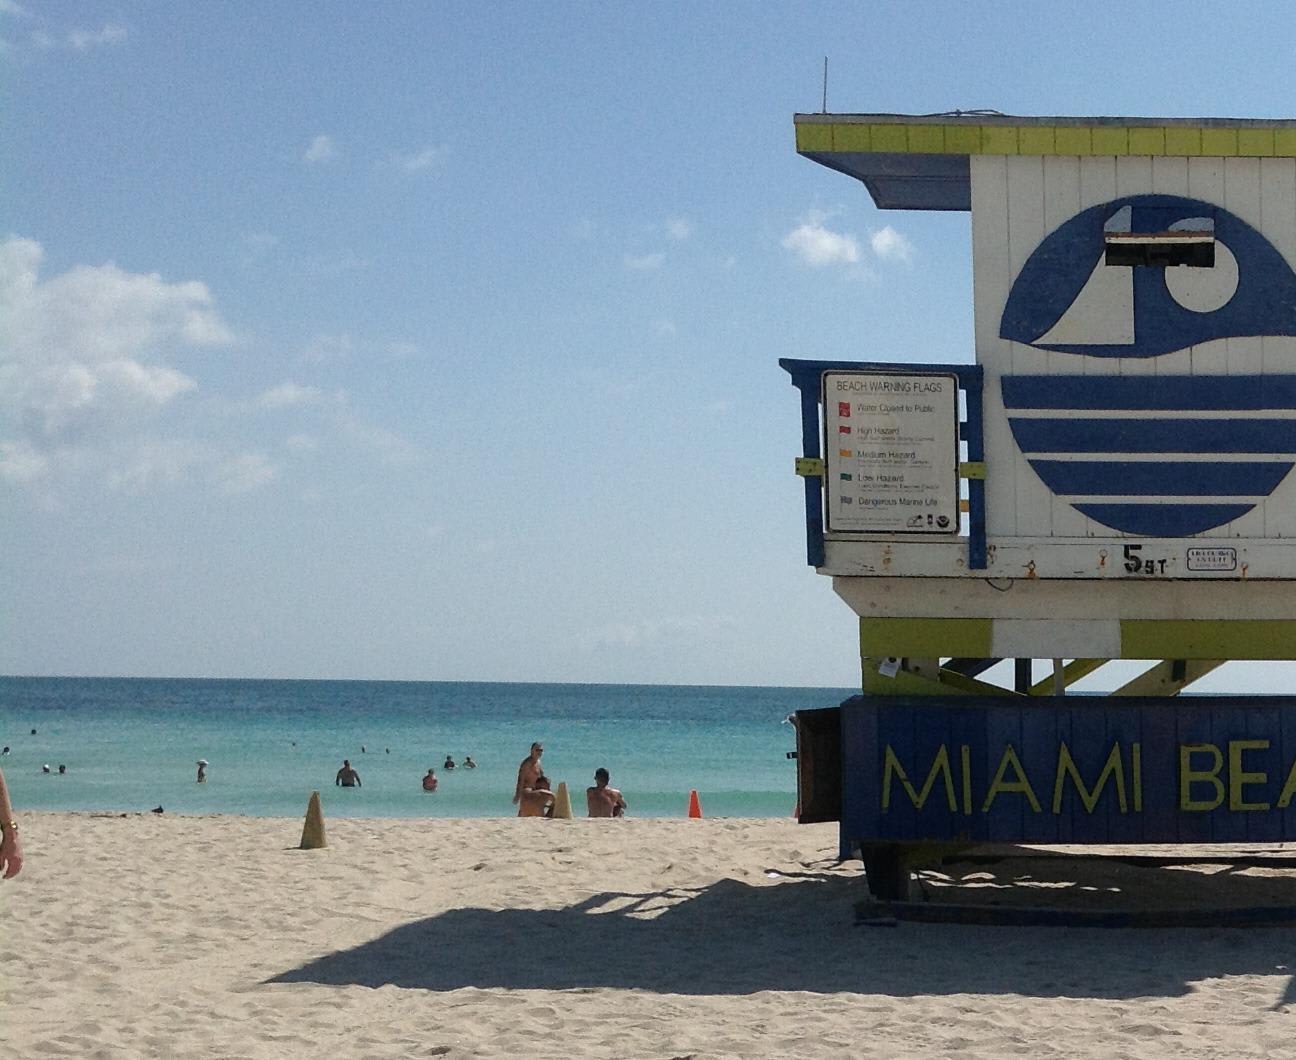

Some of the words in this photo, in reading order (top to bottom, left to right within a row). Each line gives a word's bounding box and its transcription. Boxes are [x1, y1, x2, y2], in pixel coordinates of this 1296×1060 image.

[837, 381, 867, 392] BEACH
[870, 381, 911, 393] WARNING
[913, 382, 942, 393] FLAGS
[857, 427, 873, 437] High
[875, 427, 900, 435] Hazard
[858, 497, 897, 507] Dangerous
[899, 498, 921, 506] Marine
[882, 741, 1143, 815] MIAMI
